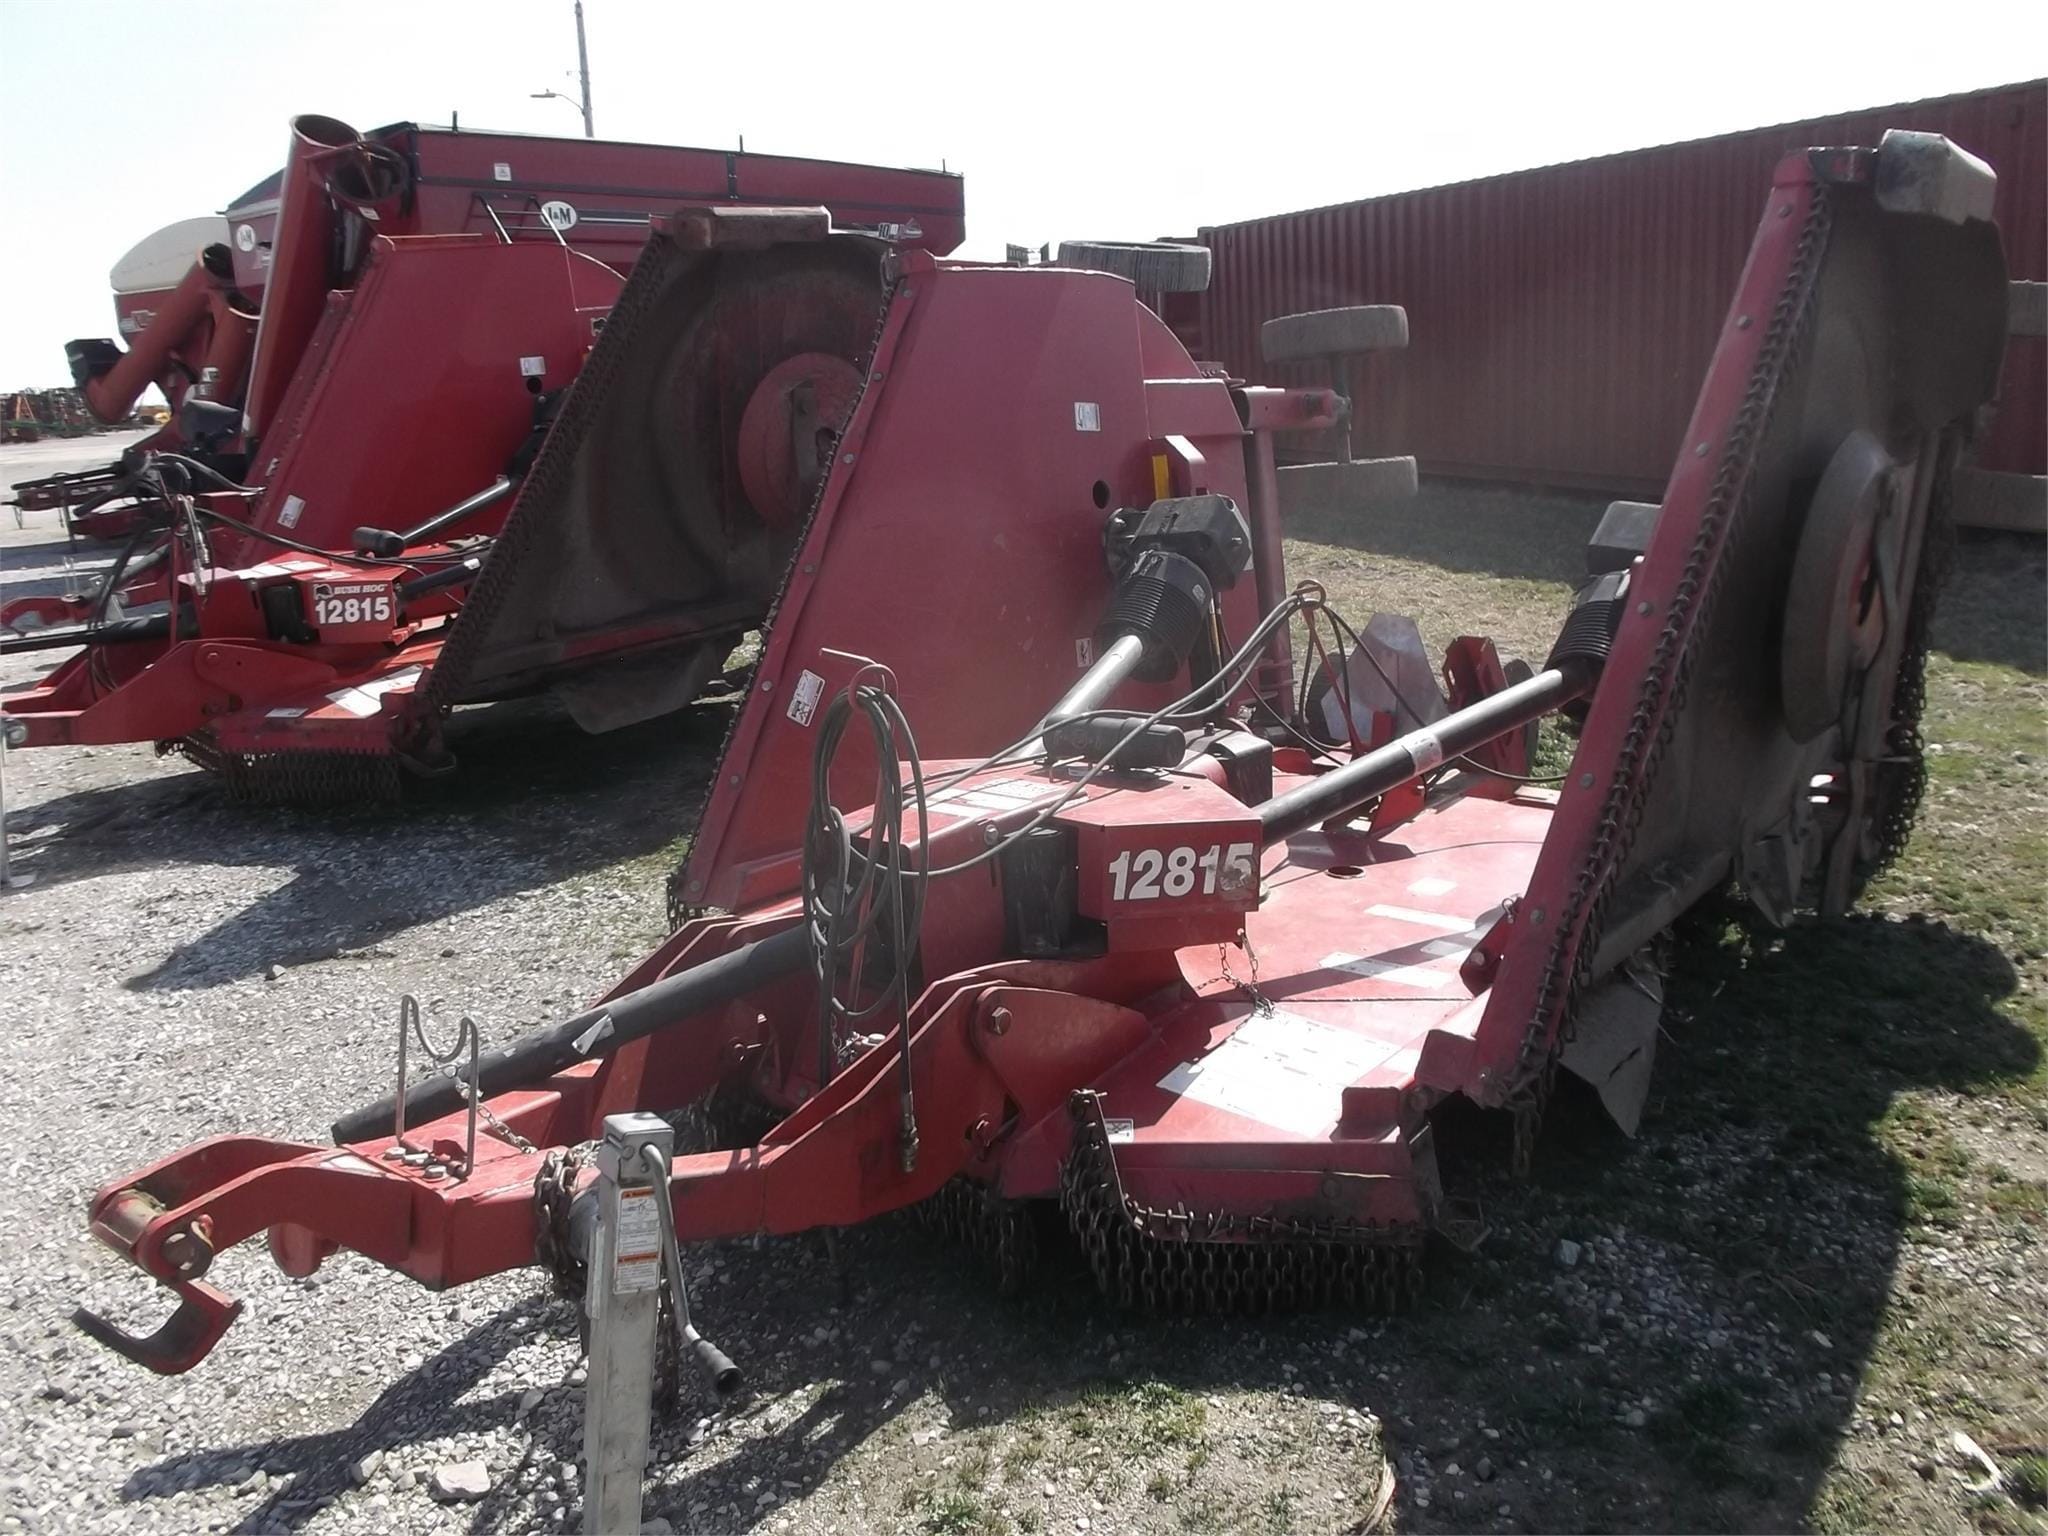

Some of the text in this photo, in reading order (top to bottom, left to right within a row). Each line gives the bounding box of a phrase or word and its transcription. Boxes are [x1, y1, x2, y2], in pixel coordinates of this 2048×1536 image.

[334, 584, 385, 595] BUSH HOG
[315, 597, 390, 624] 12815
[1109, 842, 1255, 900] 12815
